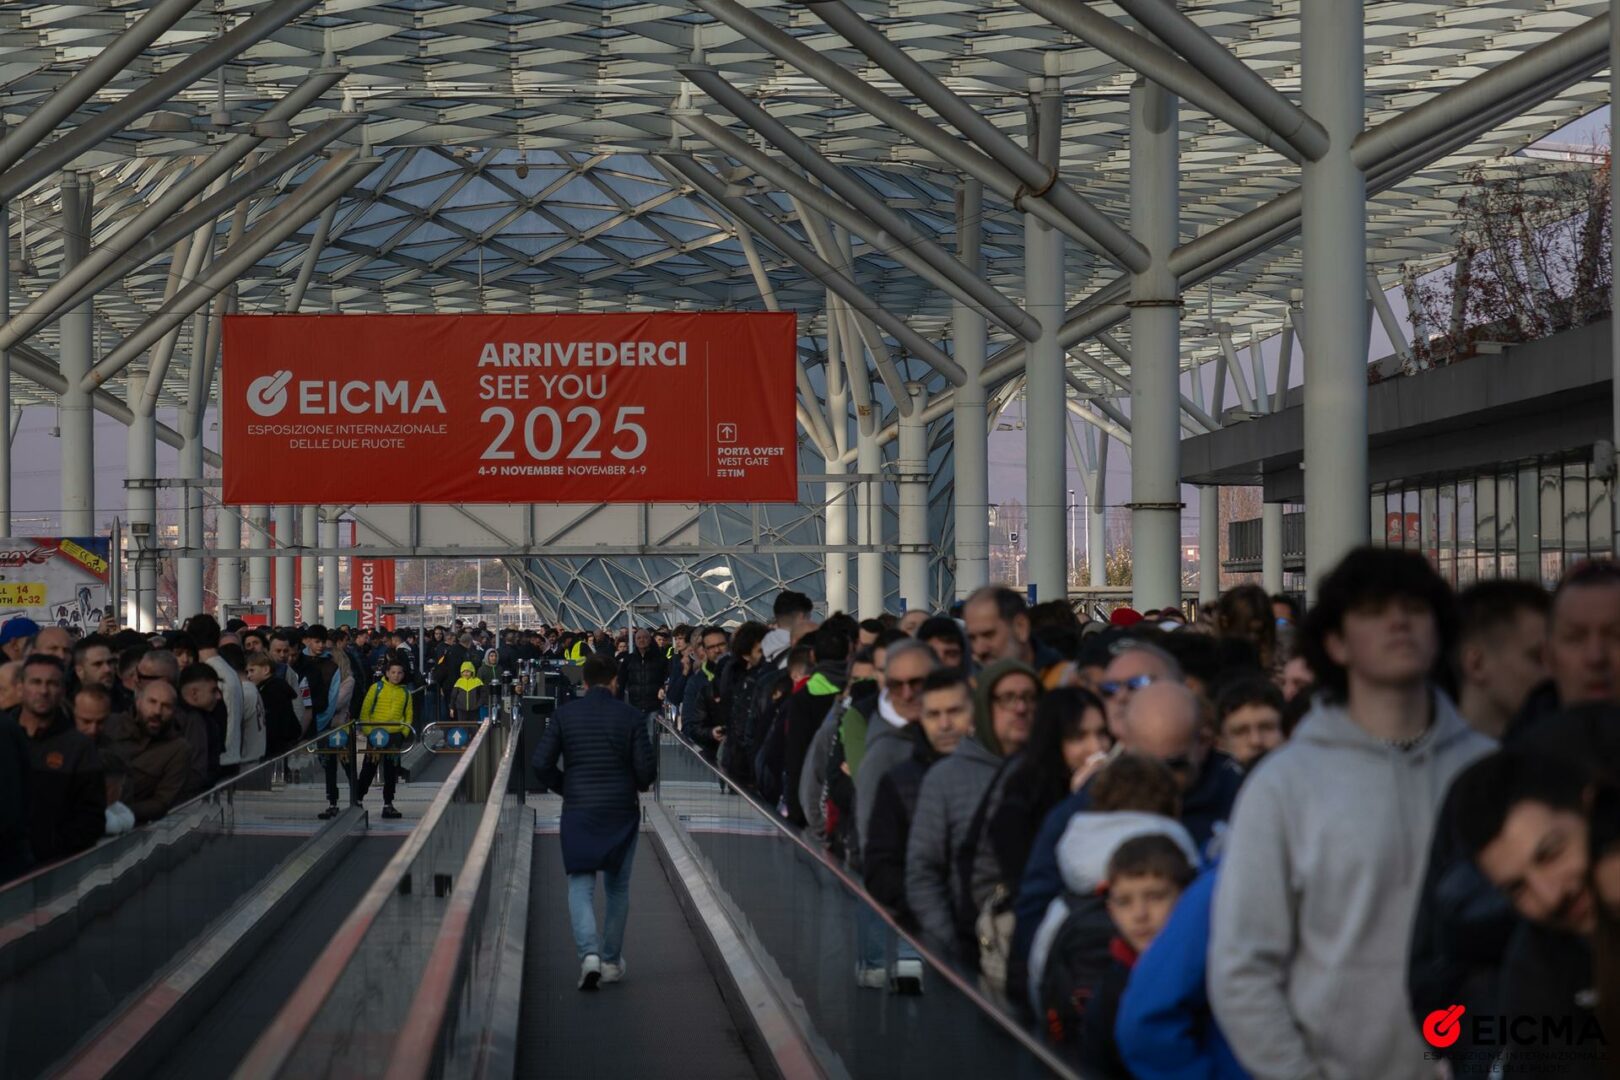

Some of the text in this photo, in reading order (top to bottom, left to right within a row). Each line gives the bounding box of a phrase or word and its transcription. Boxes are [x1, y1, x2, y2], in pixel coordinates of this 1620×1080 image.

[477, 341, 687, 368] ARRIVEDERCI
[479, 374, 607, 400] SEE YOU
[299, 380, 447, 414] EICMA
[247, 424, 447, 435] ESPOSIZIONE INTERNAZIONALE
[479, 406, 648, 461] 2025
[289, 439, 406, 449] DELLE DUE RUOTE
[717, 447, 785, 456] PORTA OVEST
[717, 457, 769, 466] WEST GATE
[478, 465, 647, 476] 4-9 NOVEMBRE NOVEMBER 4-9
